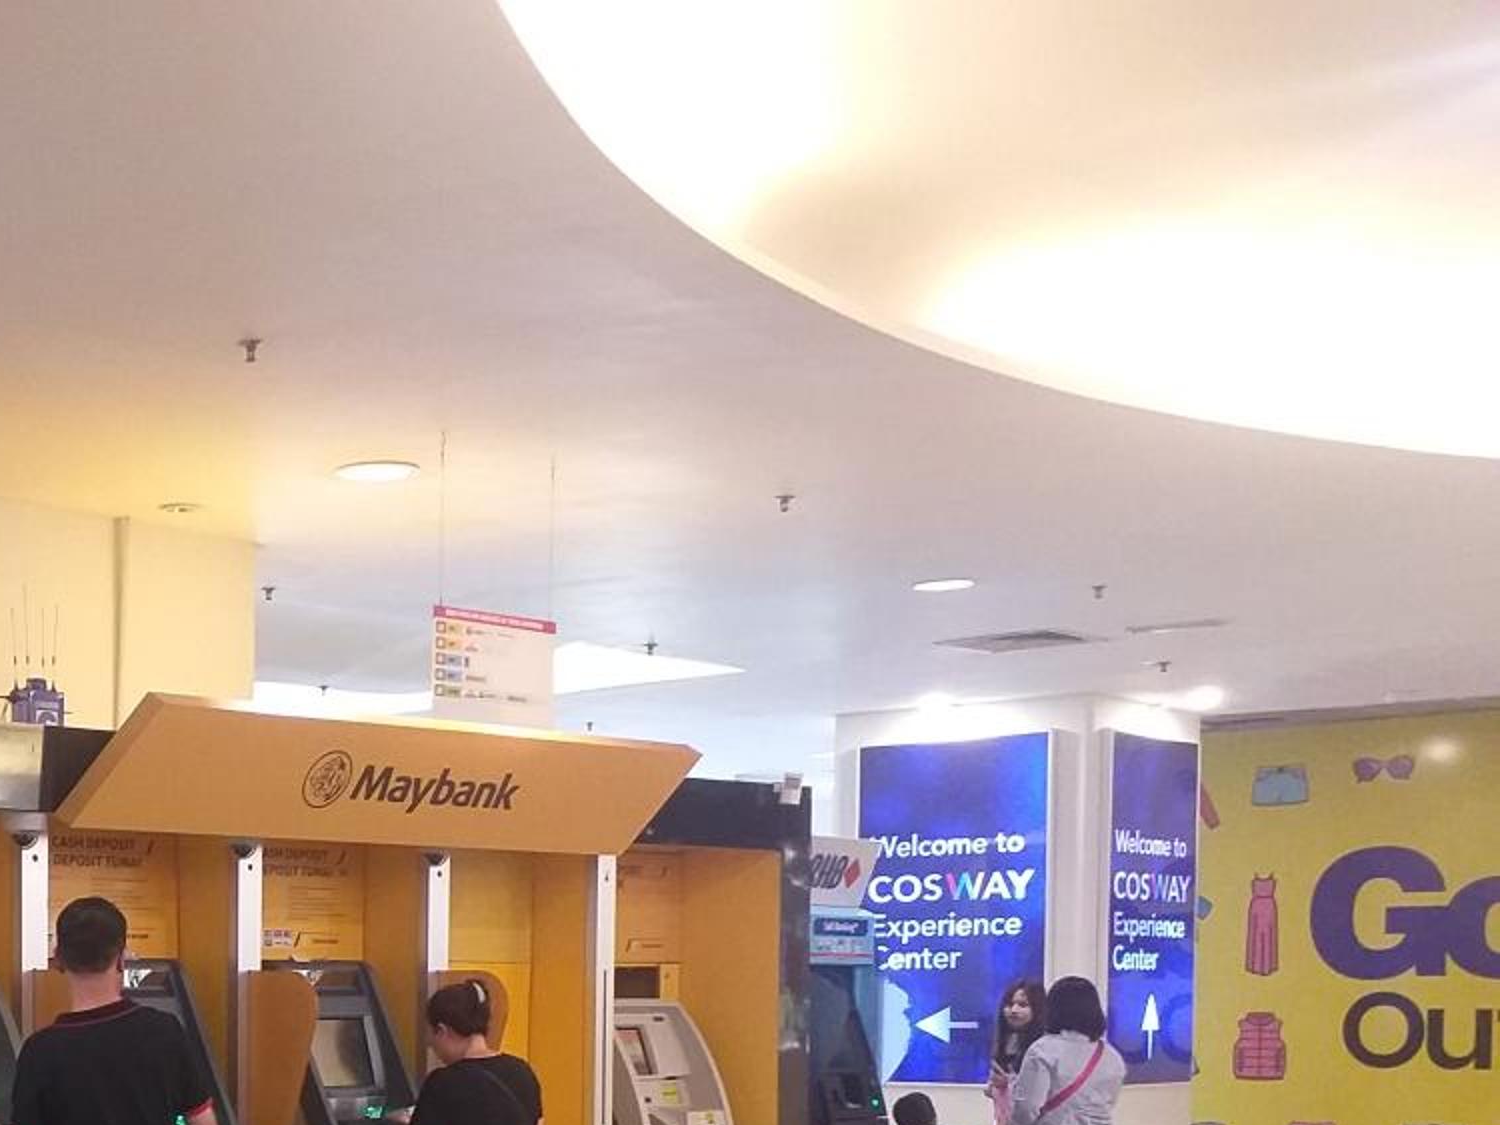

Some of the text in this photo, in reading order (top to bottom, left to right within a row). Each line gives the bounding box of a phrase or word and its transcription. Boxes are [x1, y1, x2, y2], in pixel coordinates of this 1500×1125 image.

[350, 764, 520, 814] Maybank
[995, 832, 1026, 854] to
[1114, 828, 1187, 858] Welcome to
[867, 869, 1036, 903] COSWAY
[1113, 871, 1191, 903] COSWAY
[1113, 911, 1186, 943] Experience
[1112, 944, 1159, 972] Center
[1342, 991, 1500, 1070] Ou
